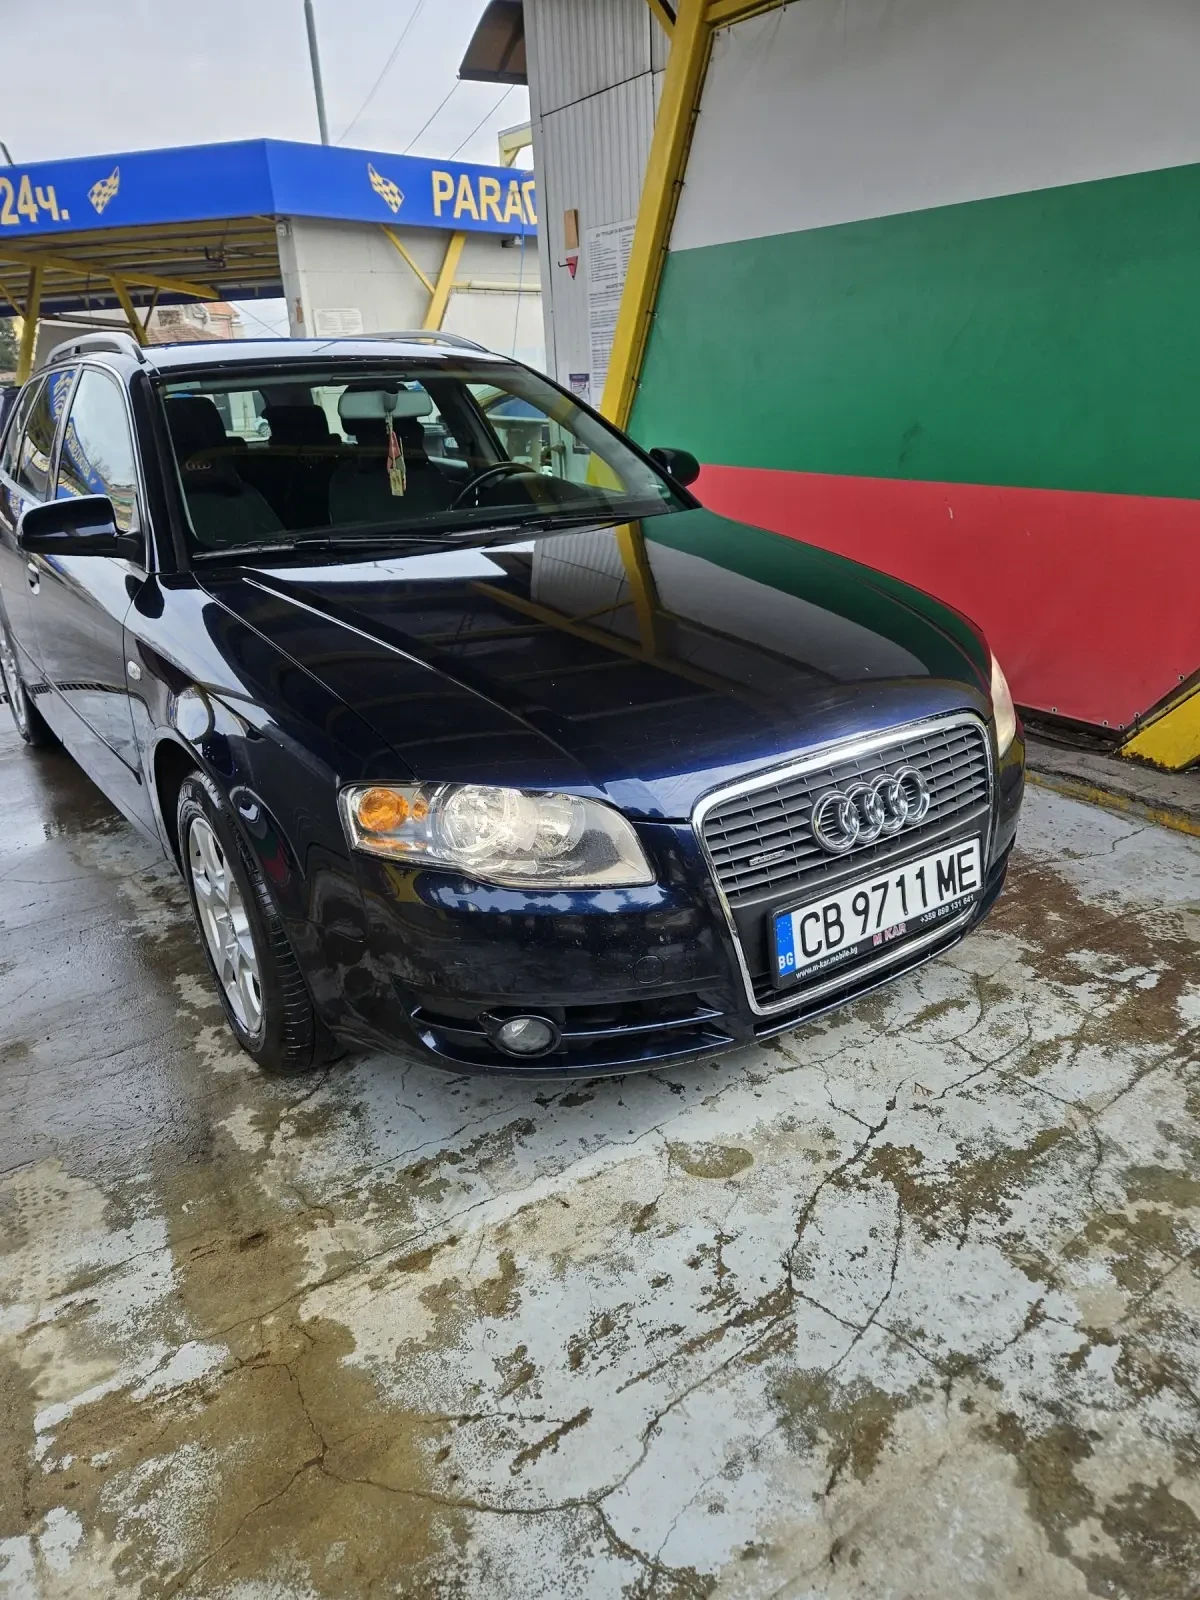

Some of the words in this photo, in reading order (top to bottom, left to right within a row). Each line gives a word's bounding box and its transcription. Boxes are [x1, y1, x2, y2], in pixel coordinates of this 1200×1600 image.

[800, 902, 845, 958] CB
[852, 866, 928, 935] 9711
[936, 847, 977, 901] ME
[884, 922, 907, 941] KAR
[778, 952, 794, 970] BG
